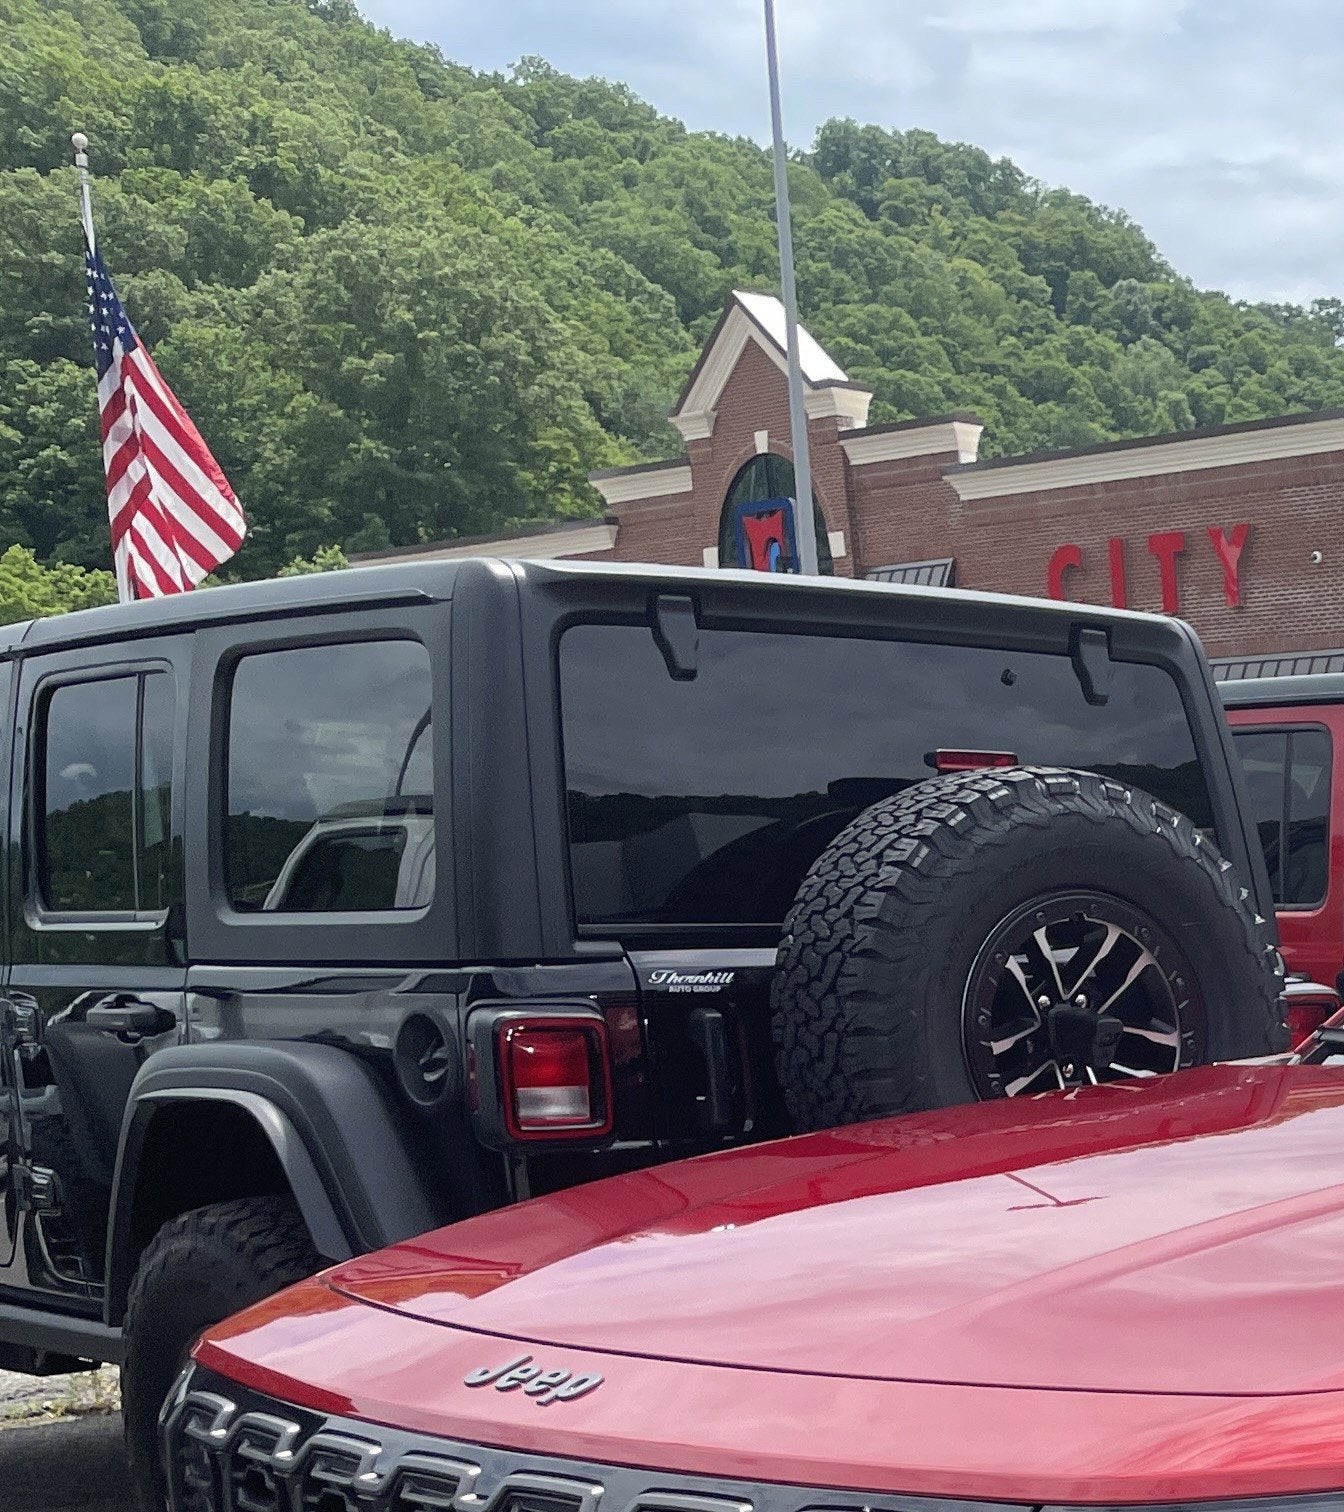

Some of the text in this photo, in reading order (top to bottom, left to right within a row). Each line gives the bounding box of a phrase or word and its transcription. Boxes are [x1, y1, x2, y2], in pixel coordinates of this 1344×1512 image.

[1046, 523, 1249, 615] CITY
[648, 969, 735, 984] Thornhill
[669, 985, 722, 993] AUTO GROUP
[463, 1354, 605, 1406] Jeep
